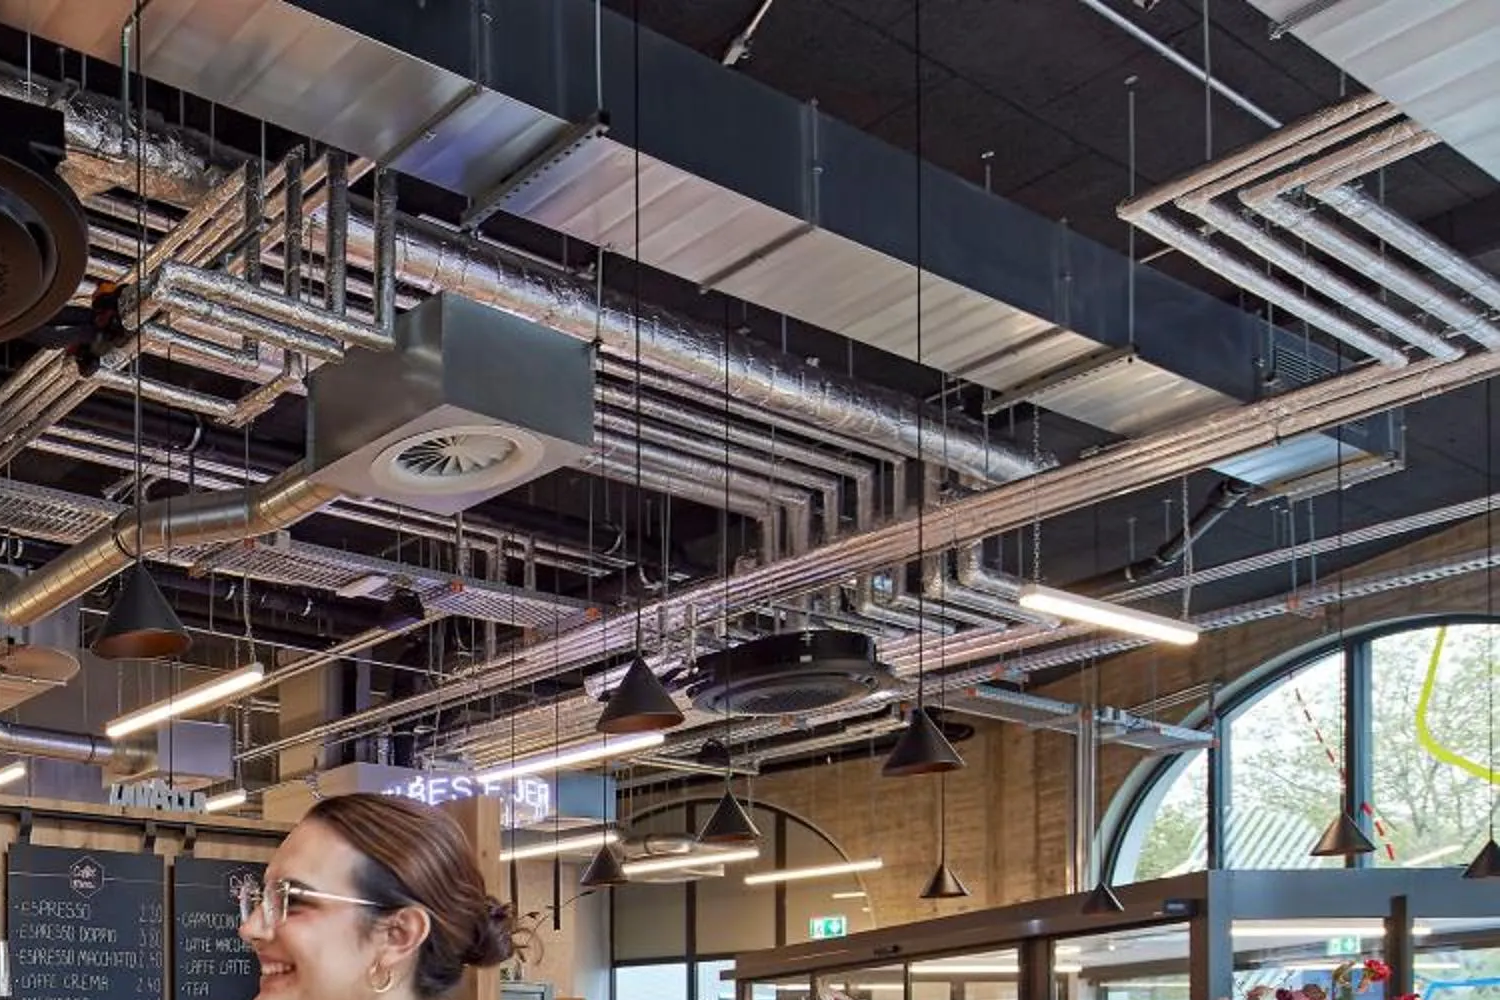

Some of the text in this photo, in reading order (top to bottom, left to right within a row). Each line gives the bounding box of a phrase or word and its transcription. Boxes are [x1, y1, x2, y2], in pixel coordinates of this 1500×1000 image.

[21, 899, 91, 920] ESPRESSO
[19, 923, 75, 942] ESPRESSO
[185, 937, 212, 953] LATTE
[19, 947, 75, 966] ESPRESSO
[219, 959, 251, 976] LATTE
[63, 973, 109, 991] CREMA
[185, 981, 209, 997] TEA
